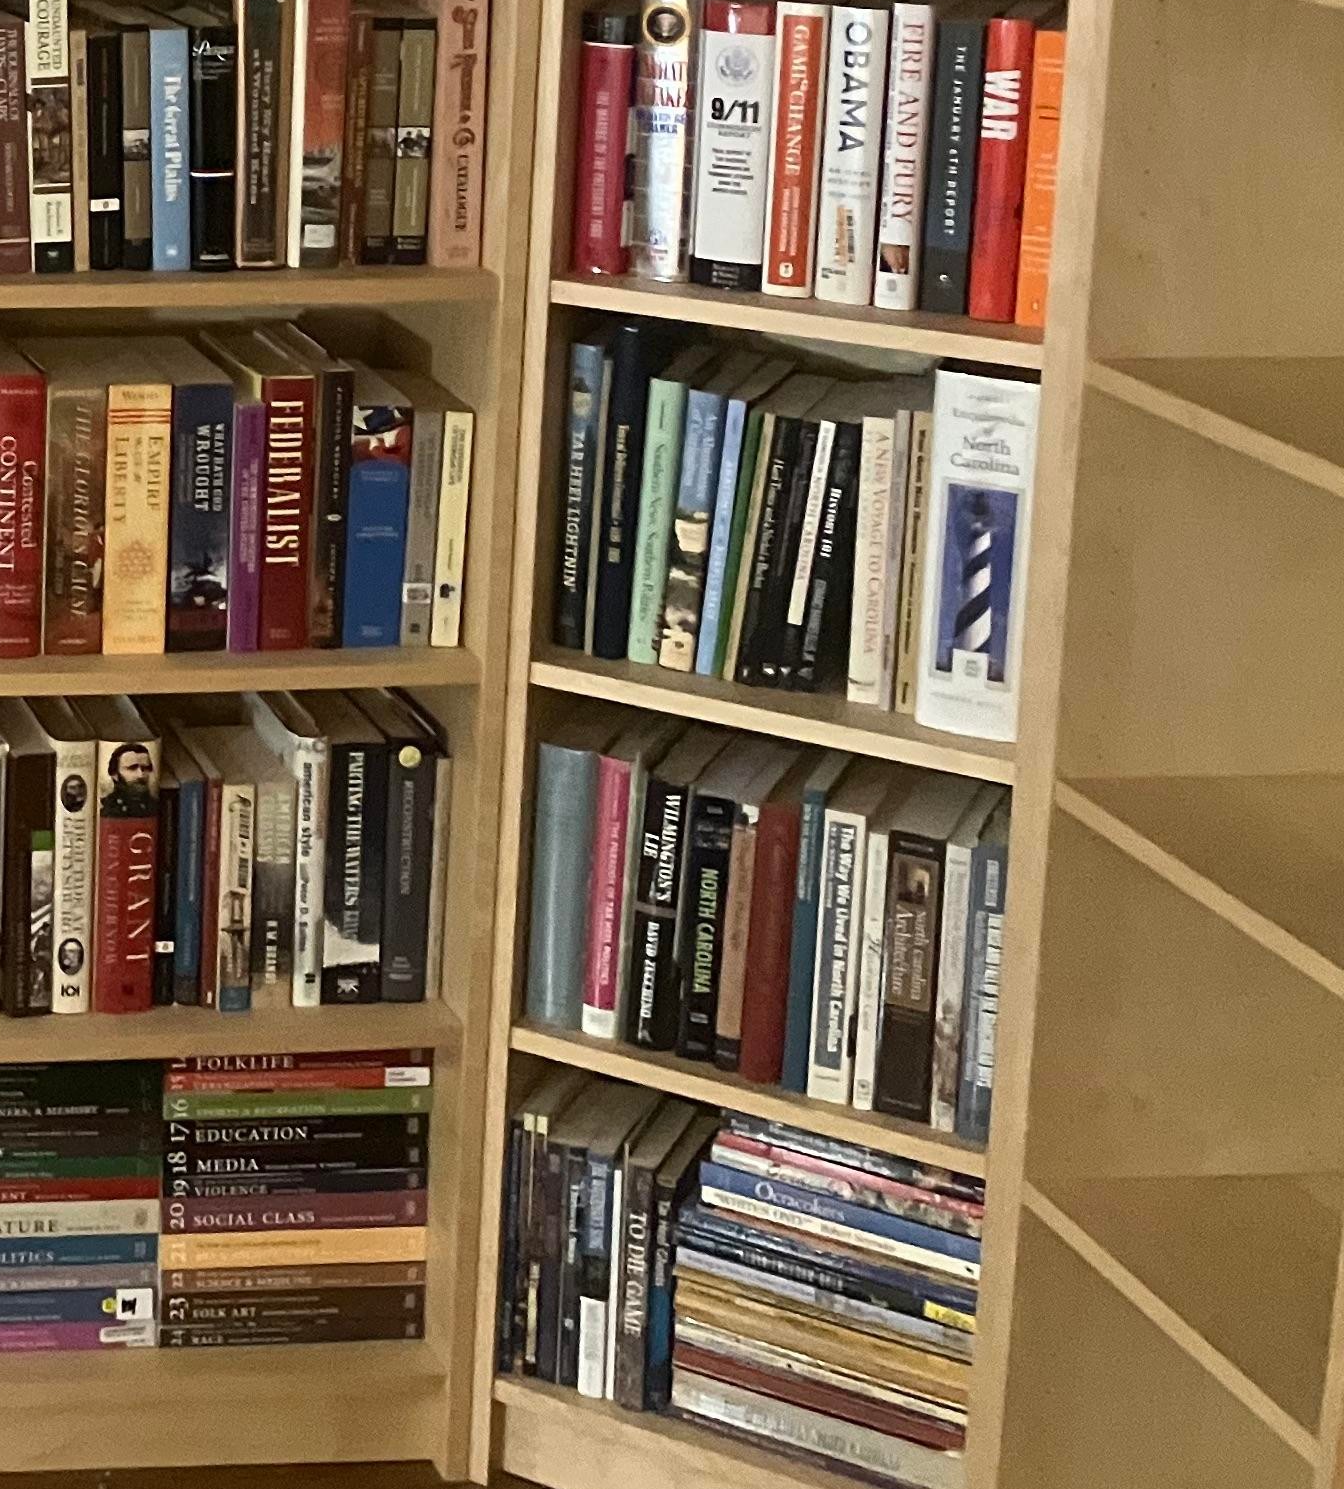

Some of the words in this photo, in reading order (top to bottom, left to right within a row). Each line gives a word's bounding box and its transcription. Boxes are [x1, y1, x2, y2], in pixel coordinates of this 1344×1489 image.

[51, 0, 63, 73] UNDAUNTED
[902, 22, 925, 84] FIRE
[711, 97, 760, 124] 9/11
[837, 21, 873, 153] OBAMA
[981, 70, 1022, 141] WAR
[897, 93, 921, 147] AND
[891, 156, 916, 223] FURY
[950, 454, 1020, 477] Carolina
[962, 436, 1011, 455] North
[20, 459, 37, 549] Contested
[265, 400, 304, 568] FEDERALIST
[643, 833, 659, 859] LIE
[657, 795, 682, 905] WILMINGTON'S
[126, 832, 153, 962] GRANT
[699, 868, 720, 918] NORTH
[691, 921, 716, 994] CAROLINA
[195, 1055, 294, 1070] FOLKLIFE
[195, 1126, 308, 1141] EDUCATION
[197, 1158, 259, 1172] MEDIA
[193, 1213, 255, 1226] SOCIAL
[262, 1210, 315, 1224] CLASS
[631, 1211, 648, 1240] TO
[624, 1280, 645, 1339] GAME
